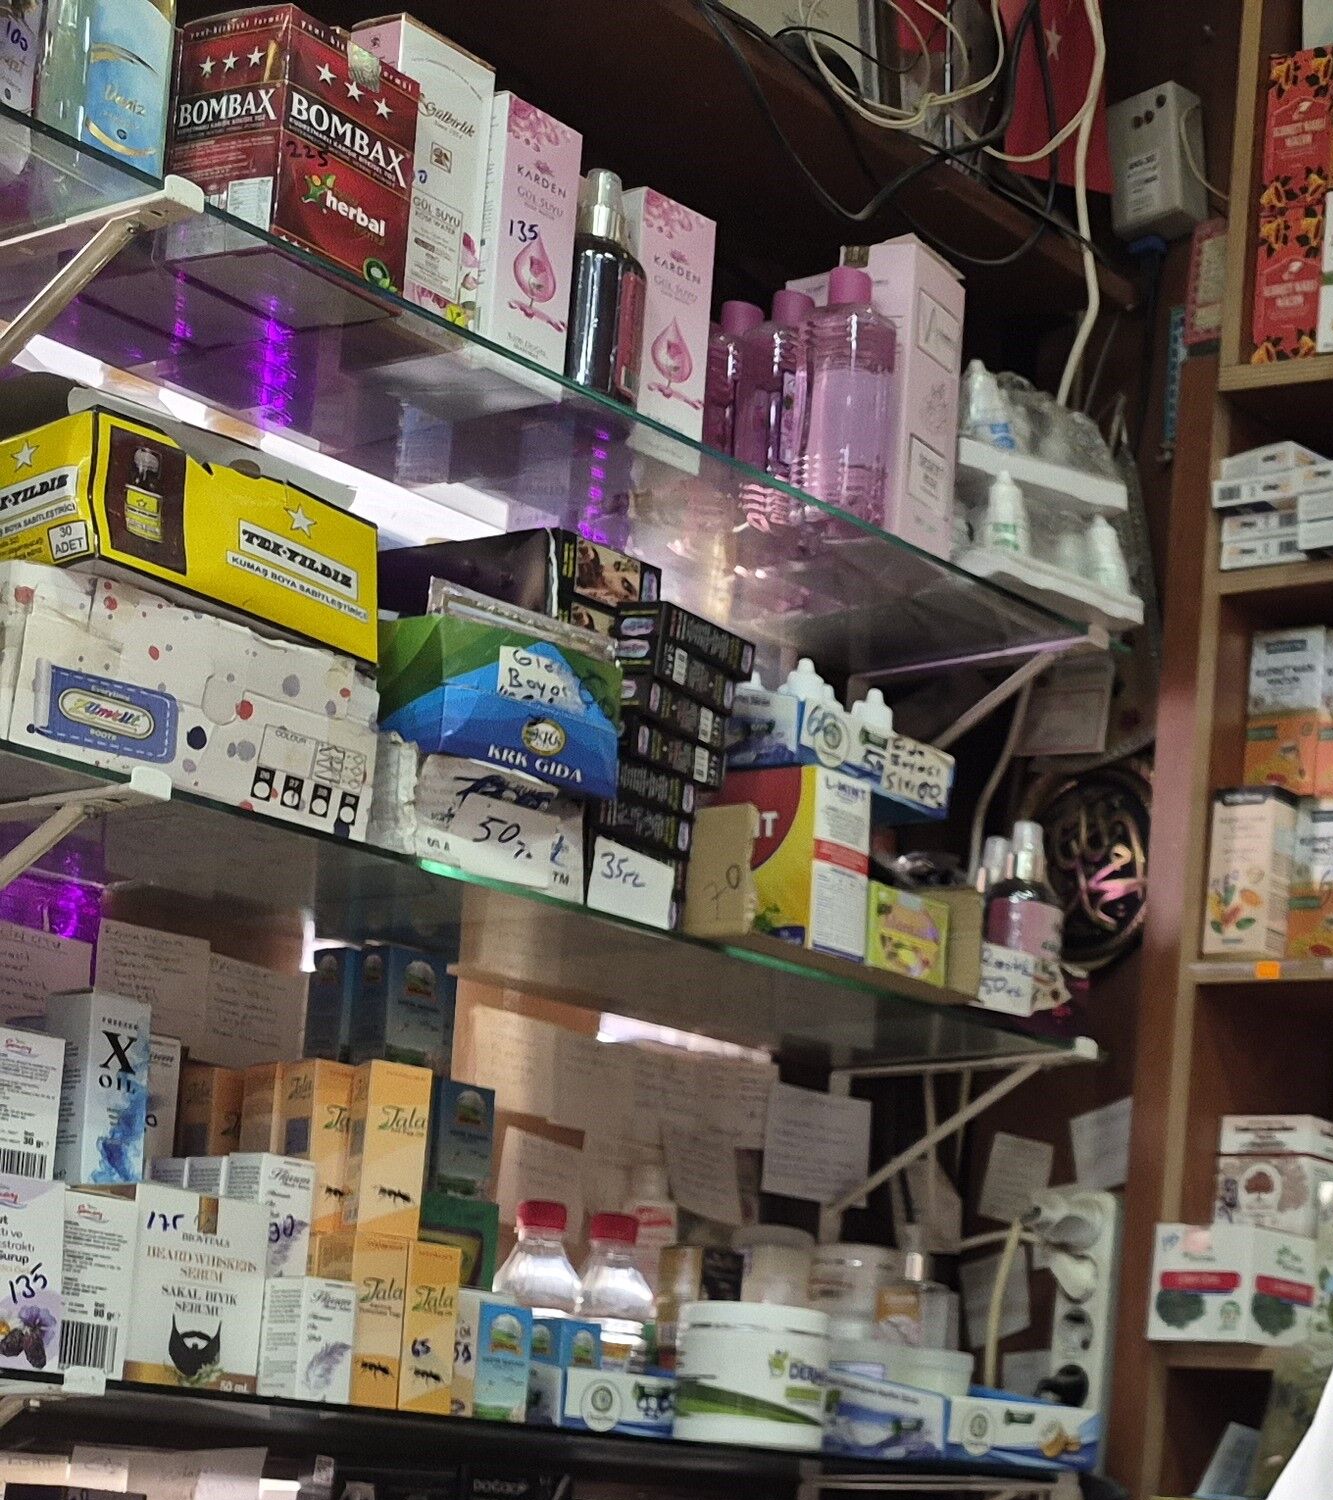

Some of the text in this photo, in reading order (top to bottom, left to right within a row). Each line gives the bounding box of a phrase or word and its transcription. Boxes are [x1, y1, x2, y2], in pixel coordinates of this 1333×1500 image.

[177, 87, 278, 128] BOMBAX
[285, 140, 329, 168] 225
[289, 90, 408, 189] BOMBAX
[516, 163, 568, 199] KARDEN
[324, 187, 388, 237] herbal
[508, 219, 539, 243] 135
[652, 253, 703, 285] KARDEN
[54, 536, 86, 556] ADET
[58, 524, 73, 538] 30
[231, 555, 298, 590] KUMAŞ BOYA
[486, 743, 585, 785] KRK GIDA
[98, 1029, 139, 1075] X
[98, 1073, 137, 1096] OIL
[8, 1262, 49, 1304] 135
